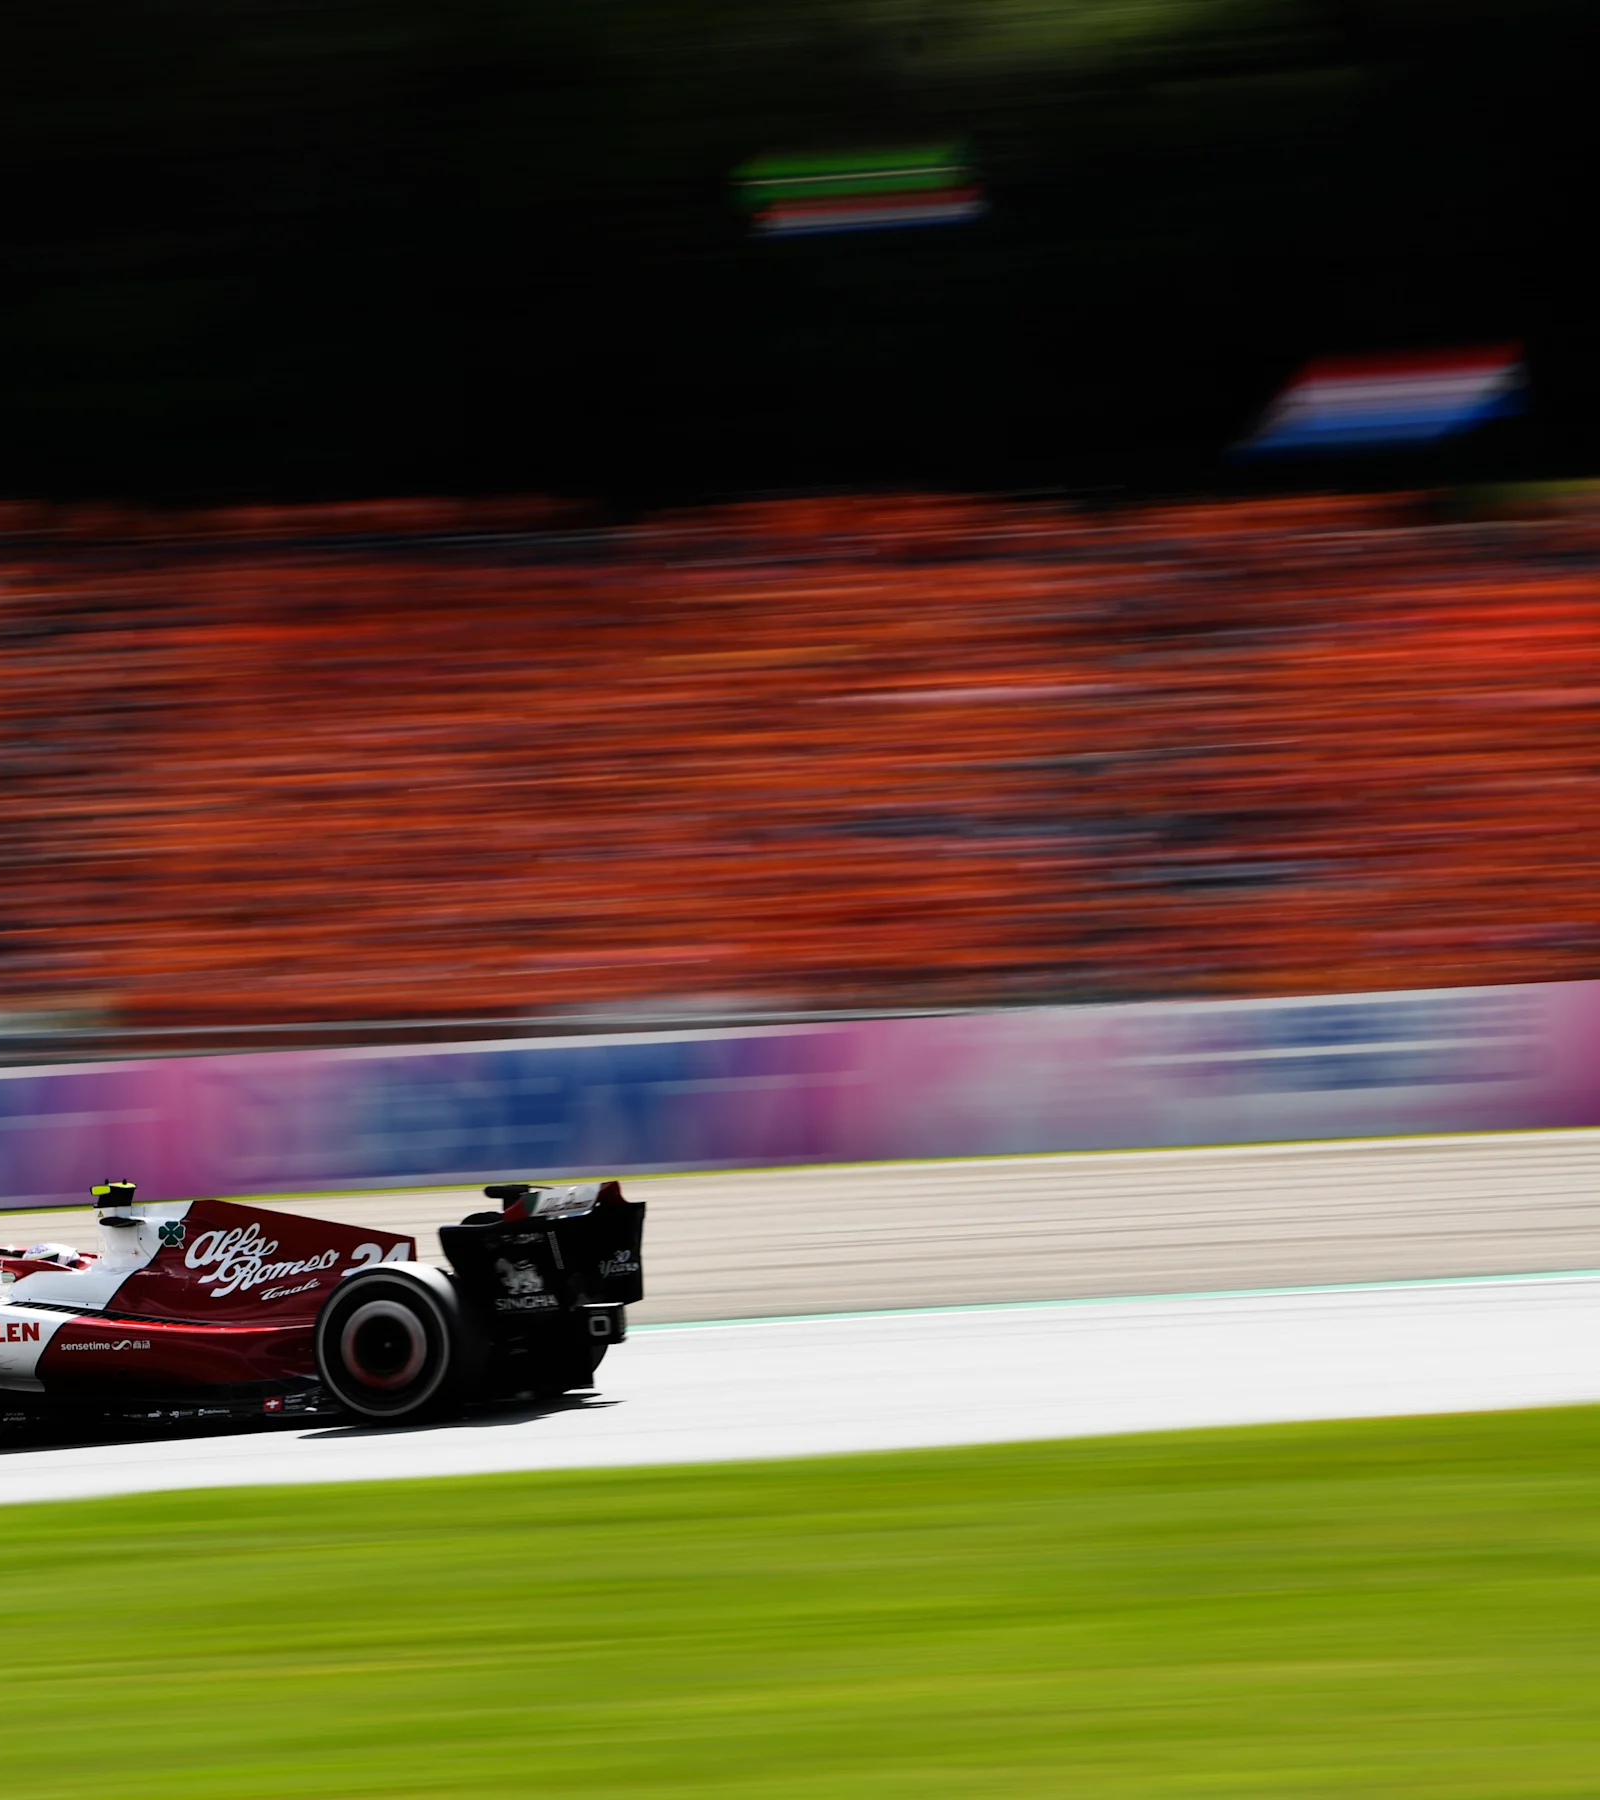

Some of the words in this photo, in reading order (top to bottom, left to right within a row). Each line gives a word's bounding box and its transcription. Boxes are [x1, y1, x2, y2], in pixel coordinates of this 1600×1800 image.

[184, 1222, 279, 1270] Alfa
[197, 1249, 340, 1298] Romeo
[259, 1278, 321, 1301] Tonale
[494, 1294, 560, 1311] SINGHA
[61, 1342, 110, 1351] sensetime
